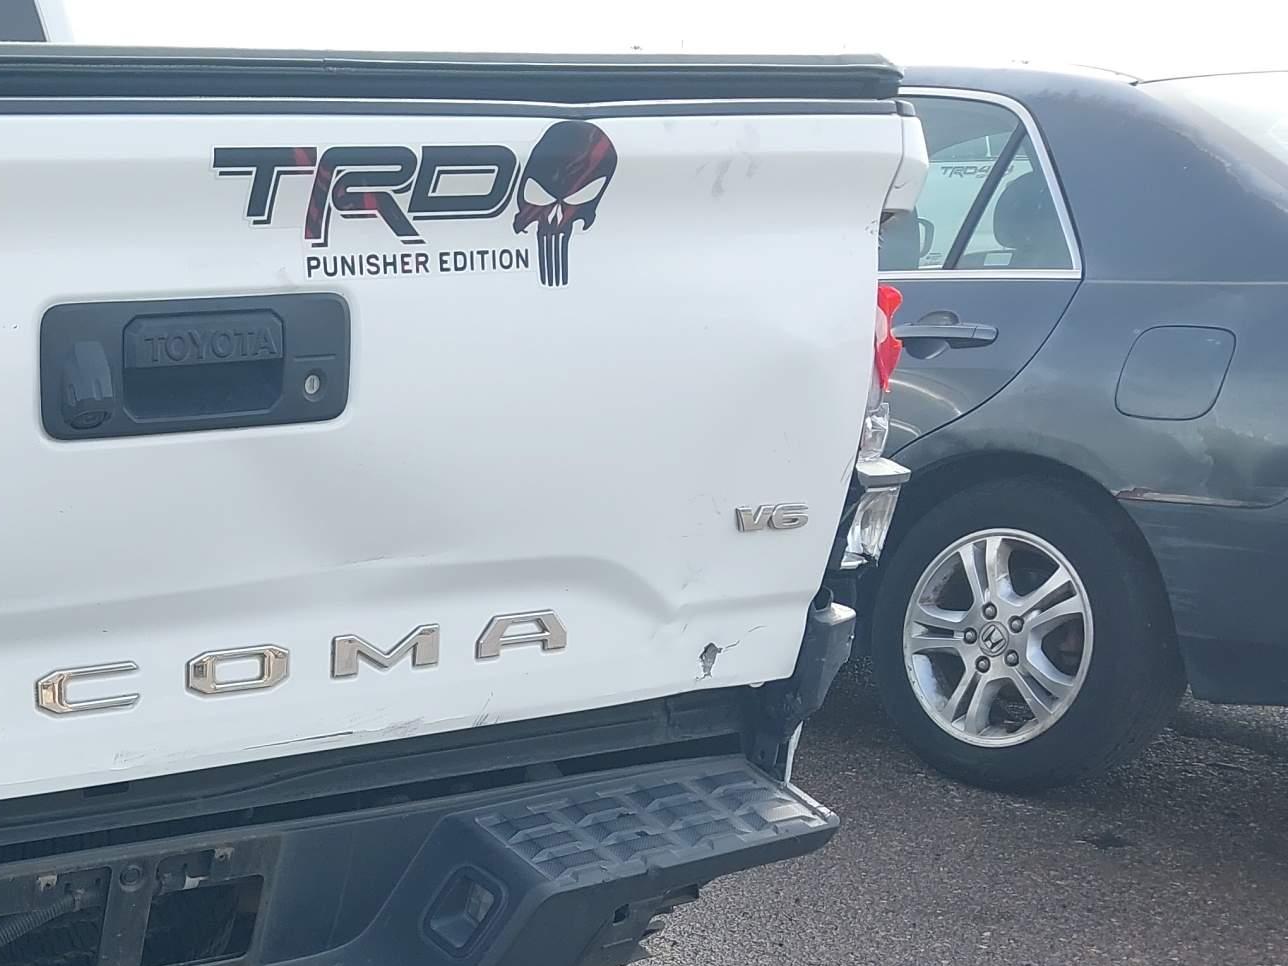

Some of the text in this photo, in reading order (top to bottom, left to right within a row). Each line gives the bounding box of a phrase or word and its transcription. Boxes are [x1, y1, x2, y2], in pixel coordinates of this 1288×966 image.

[213, 145, 521, 249] TRD
[306, 248, 530, 278] PUNISHER EDITION
[144, 328, 278, 363] TOYOTA
[735, 502, 809, 532] V6
